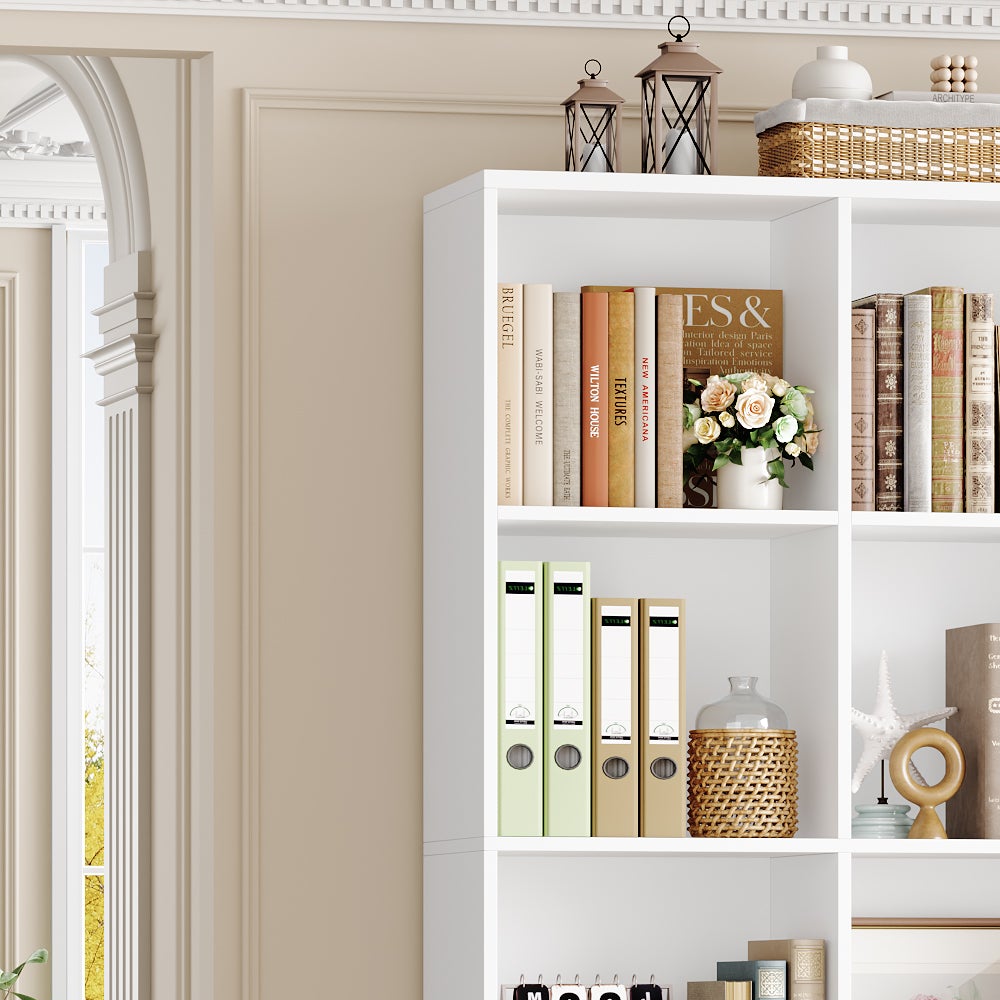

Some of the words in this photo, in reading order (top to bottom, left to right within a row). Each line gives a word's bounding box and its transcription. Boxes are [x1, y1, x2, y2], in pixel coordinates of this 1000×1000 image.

[932, 94, 976, 103] ARCHITYPE
[502, 287, 514, 350] BRUEGEL
[683, 293, 733, 328] ES
[739, 295, 772, 329] &
[711, 340, 730, 348] Idea
[734, 340, 743, 349] of
[747, 342, 773, 350] space
[718, 331, 747, 341] design
[751, 331, 773, 340] Paris
[697, 348, 736, 357] Tailored
[740, 350, 773, 358] service
[732, 358, 773, 367] Emotions
[535, 348, 544, 395] WABI-SABI
[589, 364, 600, 403] WILTON
[614, 377, 627, 426] TEXTURES
[535, 400, 544, 446] WELCOME
[589, 407, 600, 438] HOUSE
